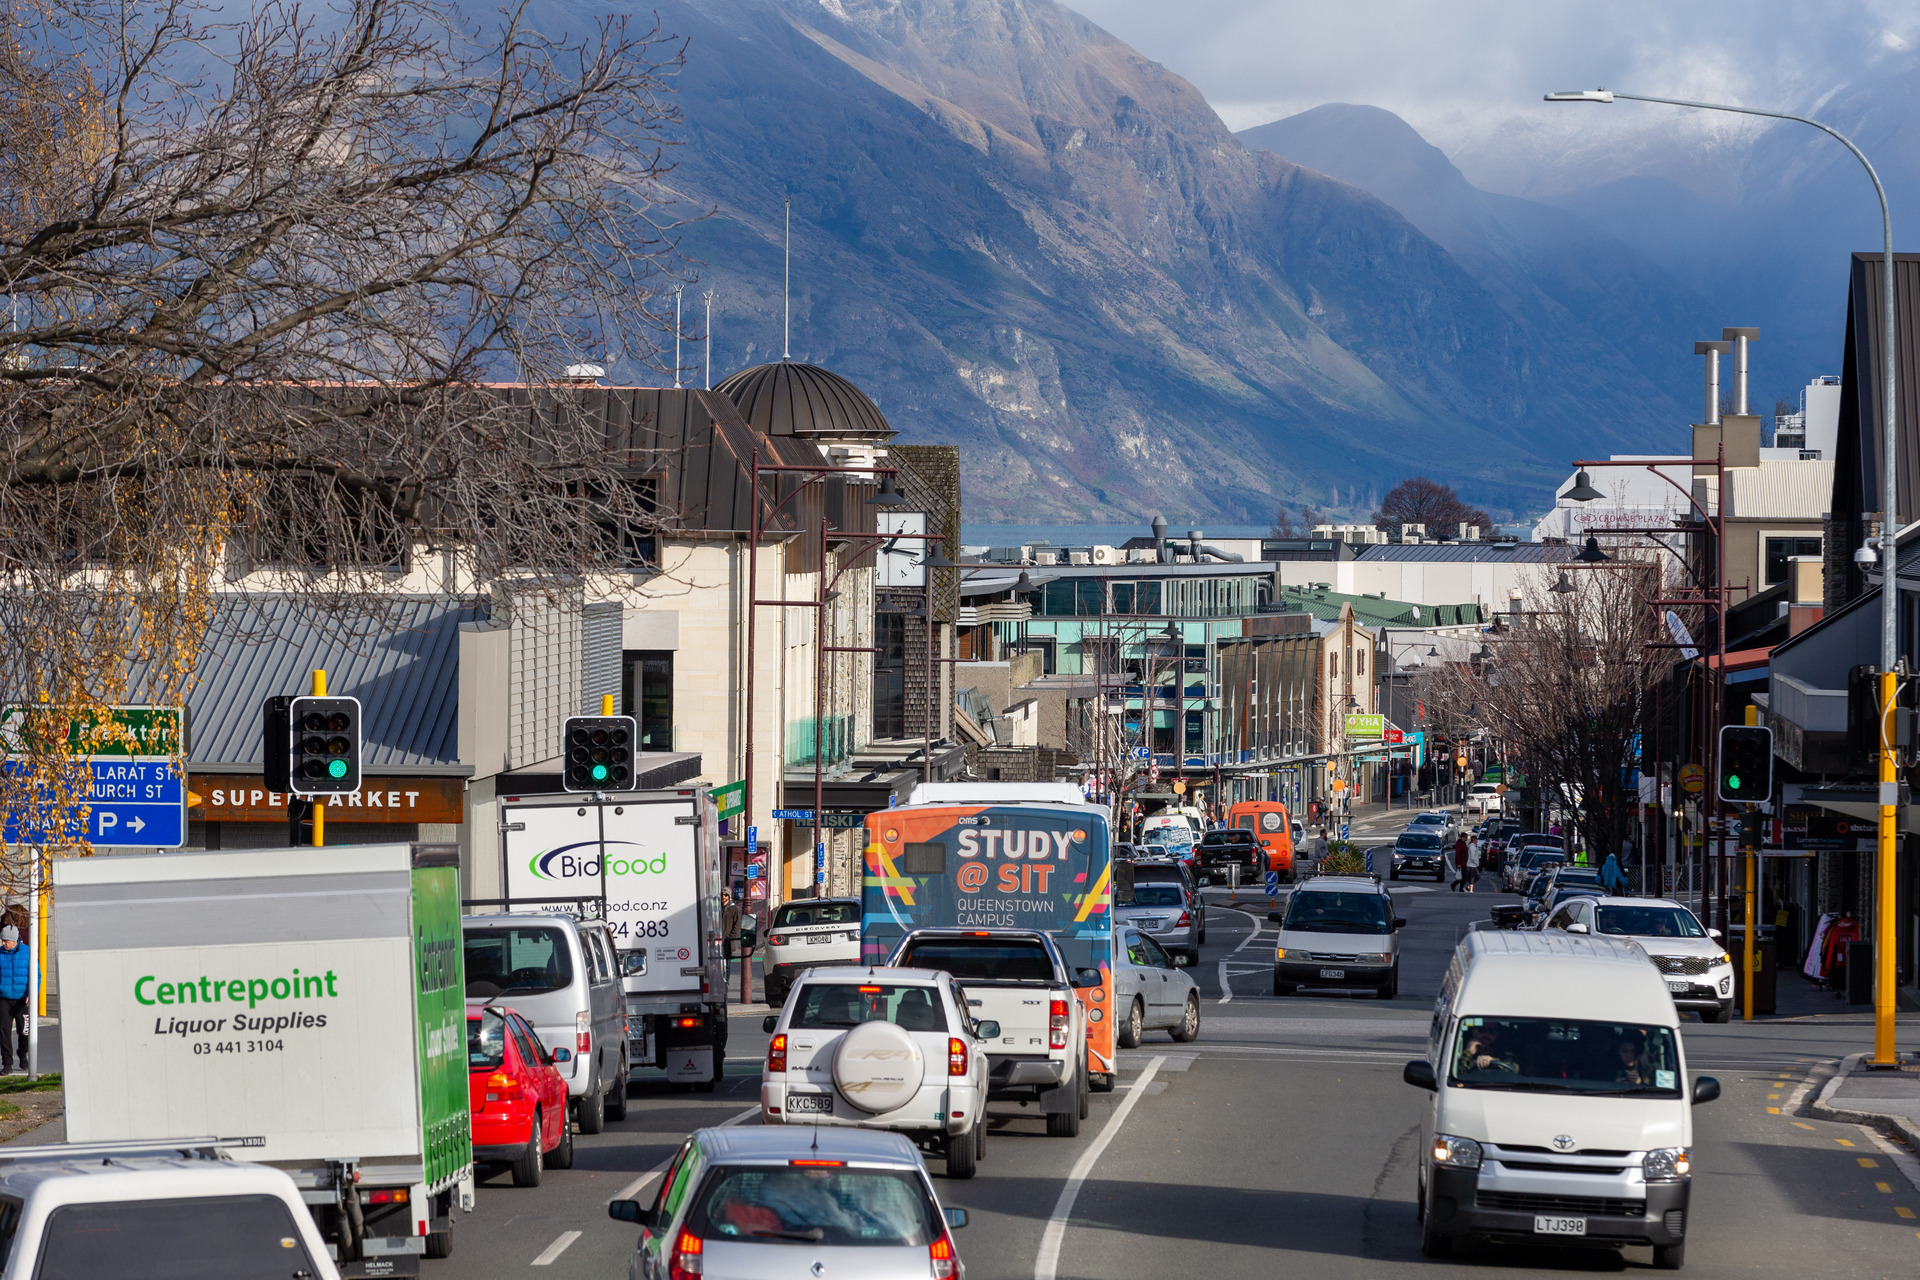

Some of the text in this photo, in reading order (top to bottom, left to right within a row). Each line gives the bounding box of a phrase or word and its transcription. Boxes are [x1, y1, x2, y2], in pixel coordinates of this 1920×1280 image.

[1598, 514, 1666, 523] CROWNE PLAZA
[1360, 717, 1380, 727] YHA
[79, 723, 172, 742] Frakton
[1142, 748, 1149, 757] P
[66, 766, 173, 781] BALARAT ST
[145, 784, 164, 799] ST
[211, 789, 420, 808] SUPEARKET
[778, 809, 802, 819] ATHOL
[804, 810, 814, 819] ST
[795, 814, 854, 828] HEISKI
[957, 817, 979, 825] QMS
[98, 811, 118, 836] P
[957, 828, 1074, 861] STUDY
[561, 851, 667, 878] Bidfood
[956, 861, 1055, 894] @ SIT
[957, 898, 1054, 912] QUEENSTOWN
[957, 912, 1015, 926] CAMPUS
[634, 919, 670, 939] 383
[795, 924, 841, 932] DISCOVERY
[134, 968, 338, 1009] Centrepoint
[154, 1011, 328, 1037] Liquor Supplies
[193, 1039, 284, 1056] 03 441 3104
[788, 1097, 832, 1110] KKC589
[365, 1261, 394, 1269] HELMACK
